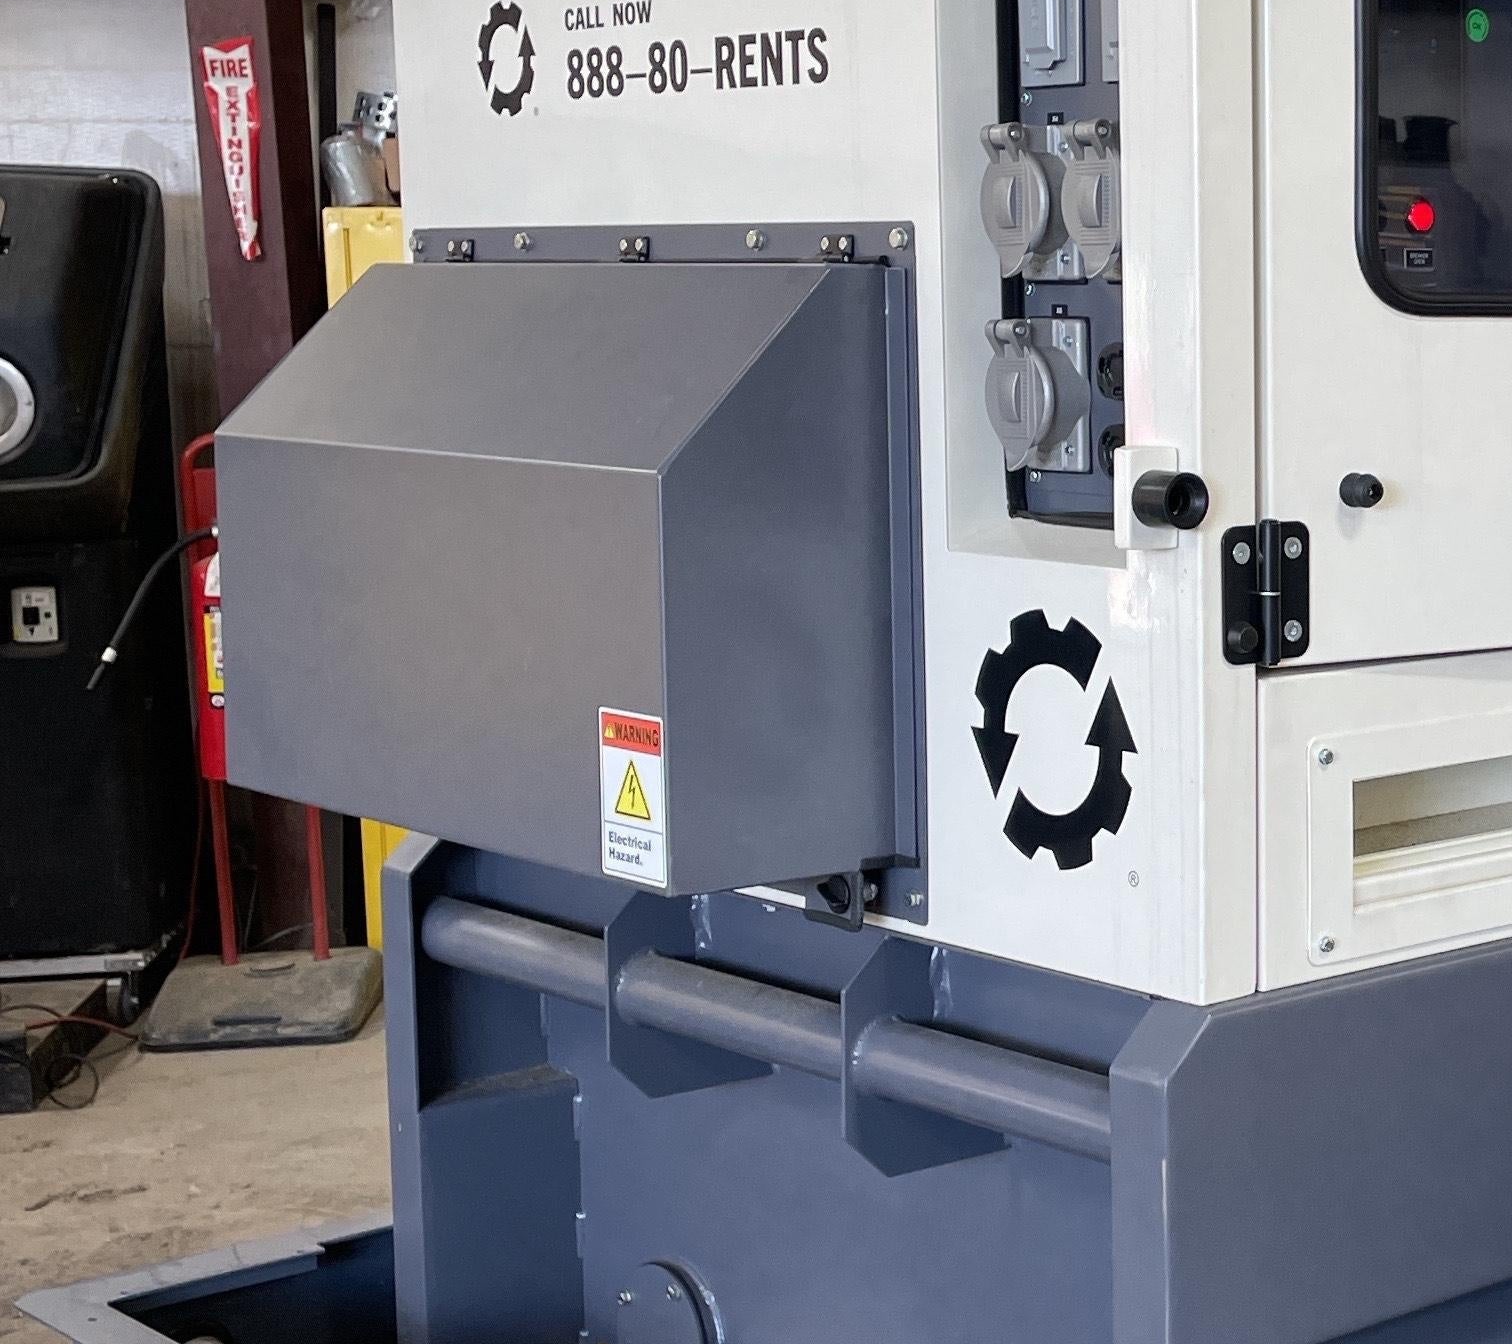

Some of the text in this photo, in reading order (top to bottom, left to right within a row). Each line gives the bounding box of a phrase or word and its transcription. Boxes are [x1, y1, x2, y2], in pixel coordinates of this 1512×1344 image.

[564, 0, 653, 32] CALL NOW
[210, 58, 249, 78] FIRE
[566, 26, 830, 99] 888-80-RENTS
[614, 721, 660, 747] WARNING
[608, 830, 652, 853] Electrical
[608, 847, 644, 868] Hazard.
